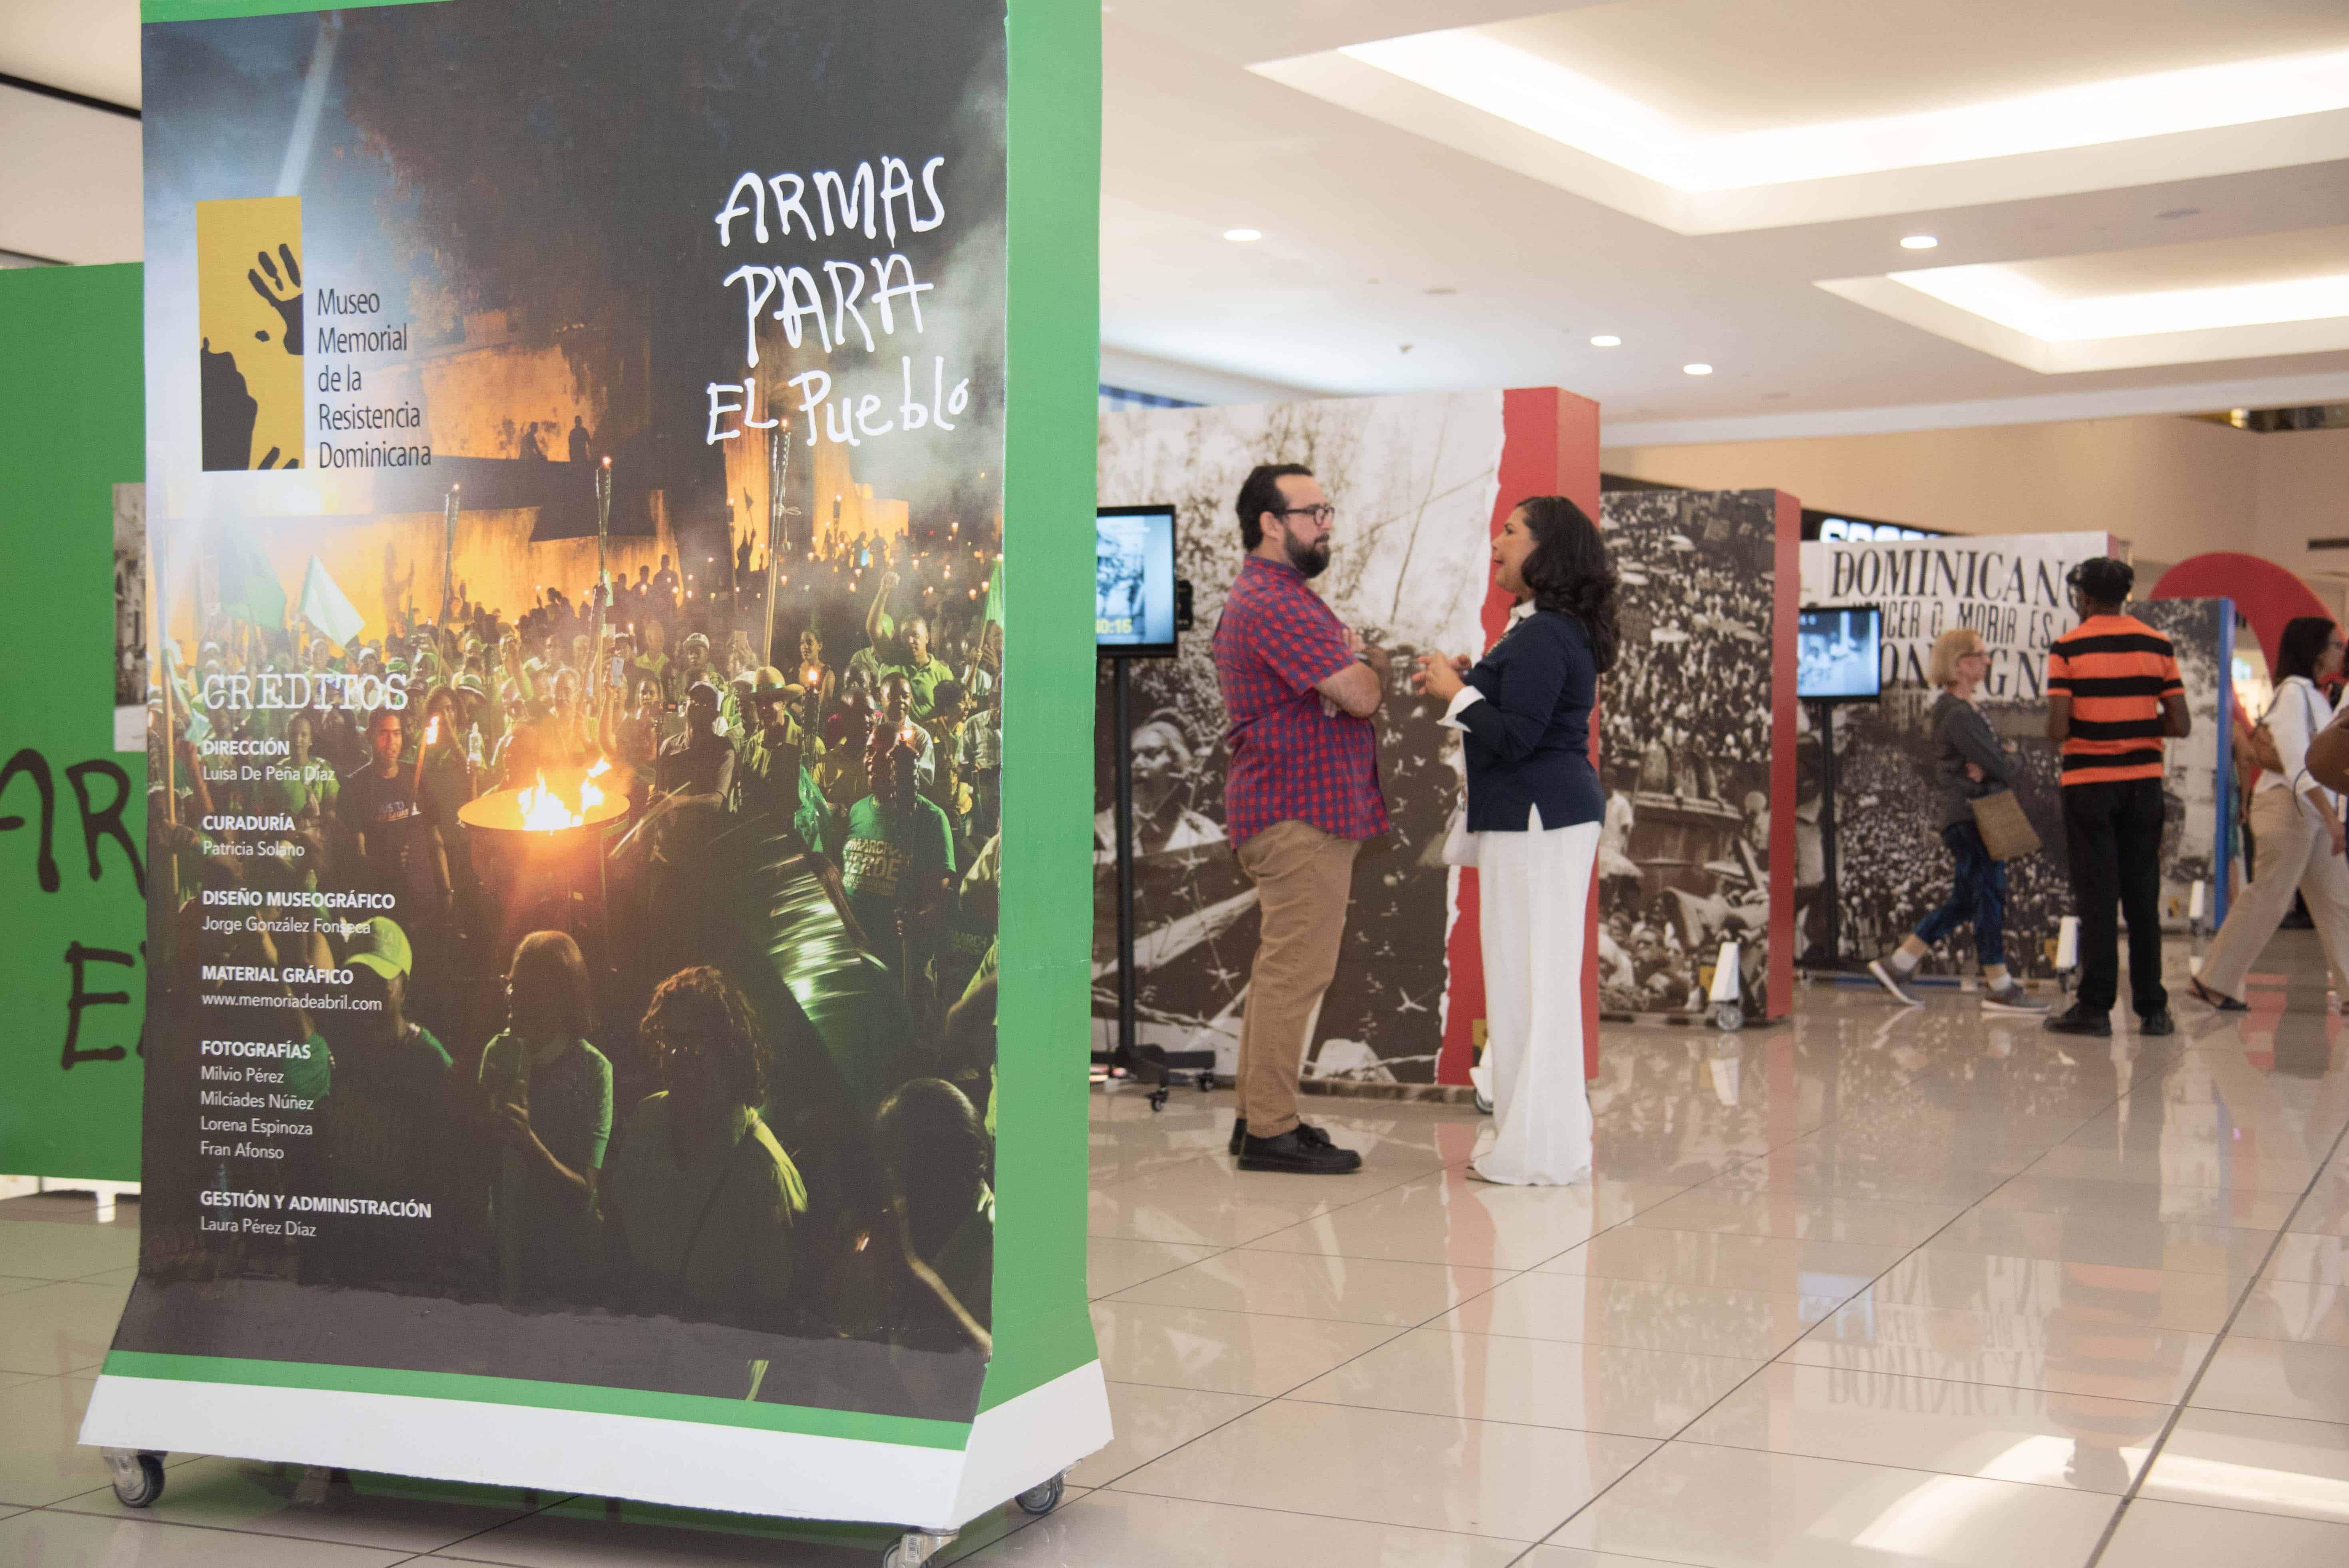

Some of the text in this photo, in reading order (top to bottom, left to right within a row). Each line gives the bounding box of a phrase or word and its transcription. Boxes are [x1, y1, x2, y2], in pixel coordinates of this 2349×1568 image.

[715, 156, 945, 248] ARMAS
[318, 288, 380, 316] Museo
[724, 254, 934, 368] PARA
[318, 323, 407, 354] Memorial
[318, 364, 362, 392] de la
[706, 356, 969, 446] EL Pueblo
[319, 401, 420, 430] Resistencia
[319, 441, 432, 468] Dominicana
[2029, 610, 2053, 649] ES
[203, 665, 408, 710] CRÉDITOS
[203, 737, 290, 755] DIRECCIÓN
[203, 766, 335, 781] Luisa De Peña Díaz
[203, 813, 295, 831] CURADURÍA
[203, 841, 305, 857] Patricia Solano
[203, 888, 396, 909] DISEÑO MUSEOGRÁFICO
[202, 916, 371, 934] Jorge González Fonseca
[202, 965, 354, 985] MATERIAL GRÁFICO
[61, 940, 146, 1071] E
[202, 992, 382, 1011] www.memoriadeabril.com
[201, 1040, 311, 1059] FOTOGRAFÍAS
[201, 1065, 284, 1083] Milvio Pérez
[201, 1091, 314, 1111] Milcíades Núñez
[201, 1116, 313, 1137] Lorena Espinoza
[201, 1141, 284, 1159] Fran Afonso
[201, 1190, 432, 1218] GESTIÓN Y ADMINISTRACIÓN
[201, 1216, 316, 1237] Laura Pérez Díaz
